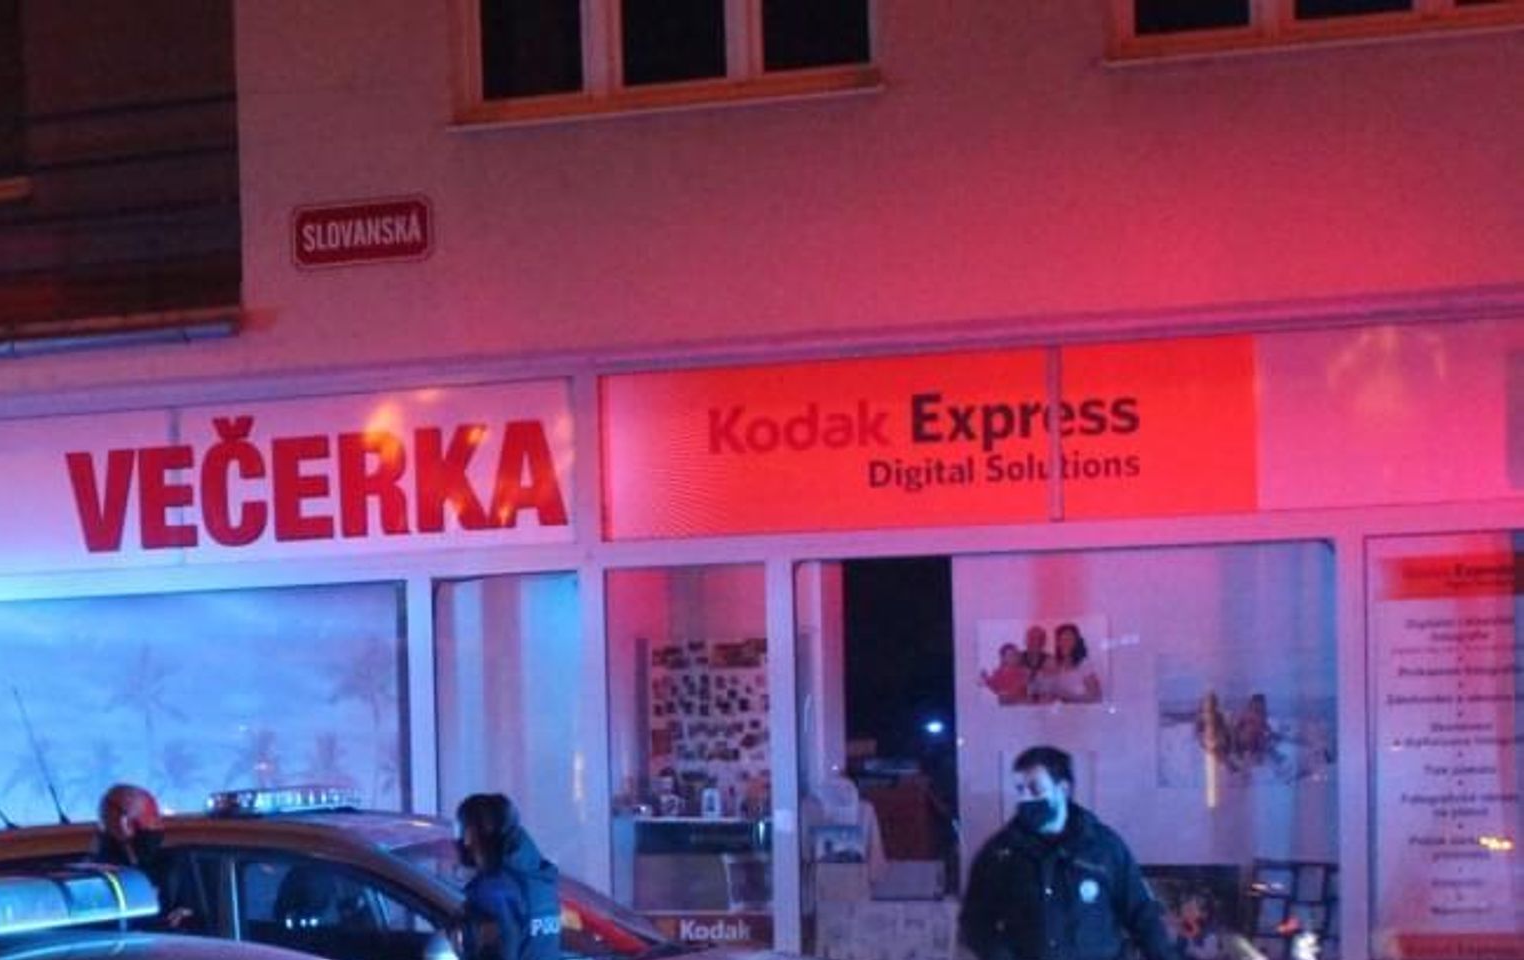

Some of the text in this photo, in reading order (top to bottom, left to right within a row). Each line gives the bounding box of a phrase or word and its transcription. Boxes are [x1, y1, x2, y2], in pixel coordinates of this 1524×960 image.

[707, 393, 1141, 455] Kodak Express
[65, 416, 568, 552] VEČERKA
[868, 449, 1141, 491] Digital Solutions
[679, 916, 752, 941] Kodak
